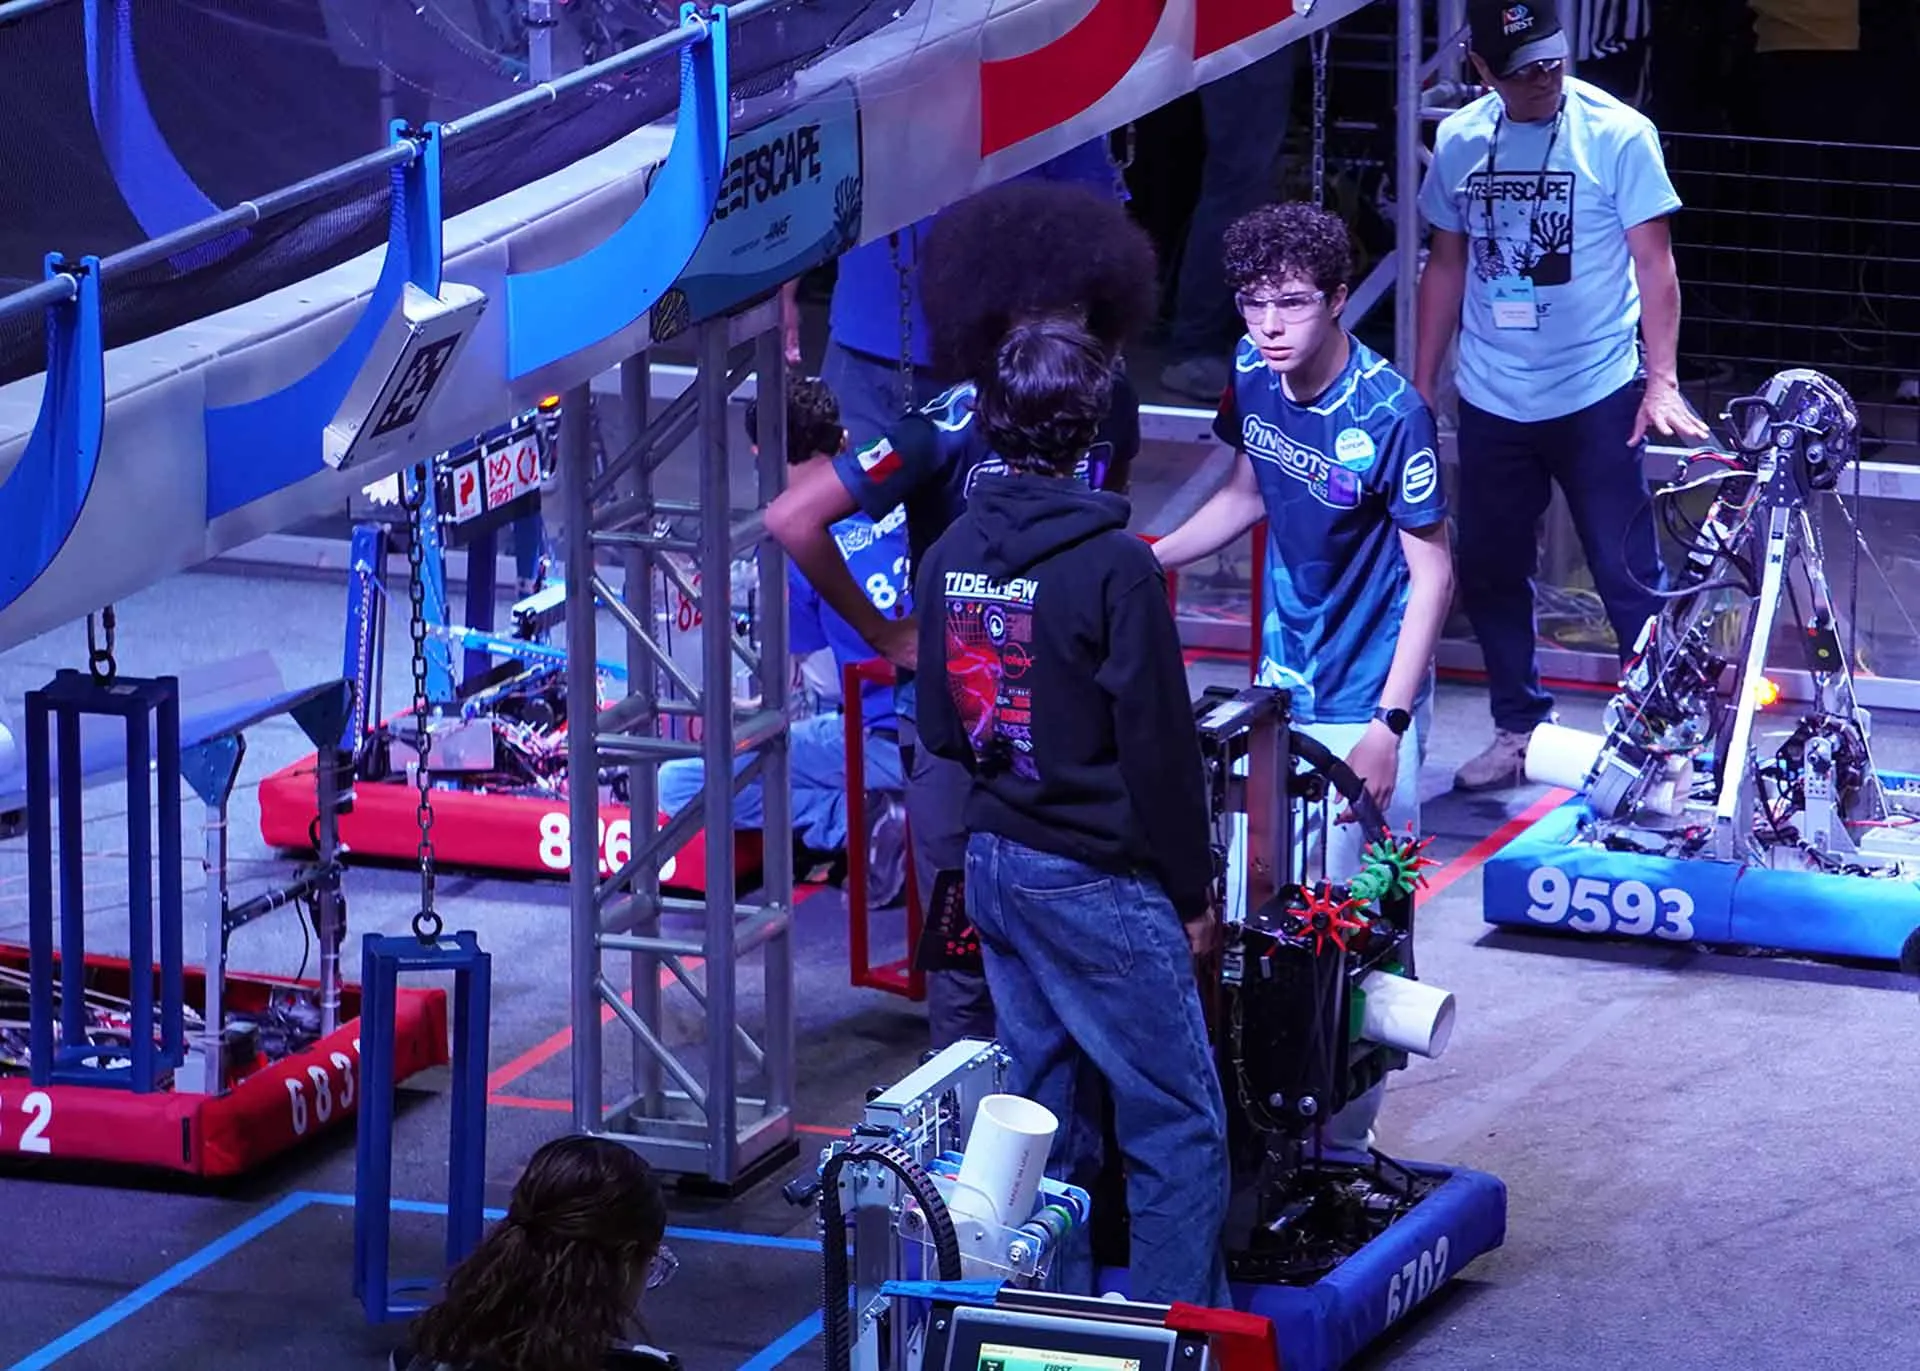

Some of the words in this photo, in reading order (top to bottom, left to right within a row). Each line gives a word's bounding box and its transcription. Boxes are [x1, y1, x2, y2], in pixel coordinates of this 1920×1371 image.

[1504, 17, 1534, 36] FIRST
[711, 125, 821, 223] EEFSCAPE
[1245, 420, 1331, 481] STINGBOTS
[1527, 866, 1694, 941] 9593
[285, 1038, 360, 1135] 683
[1385, 1236, 1449, 1329] 6702
